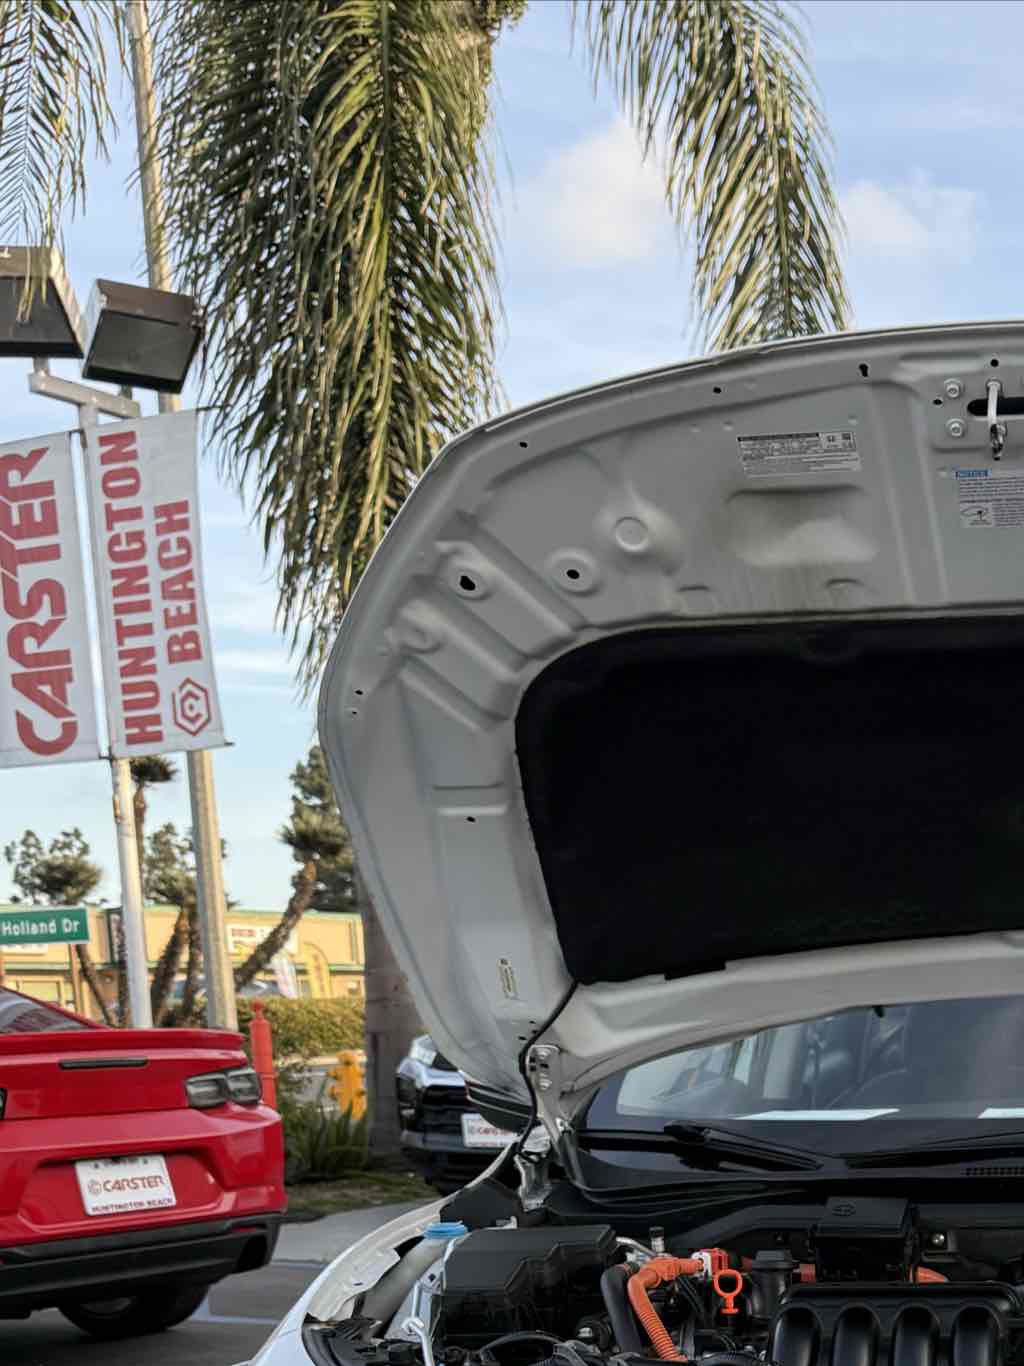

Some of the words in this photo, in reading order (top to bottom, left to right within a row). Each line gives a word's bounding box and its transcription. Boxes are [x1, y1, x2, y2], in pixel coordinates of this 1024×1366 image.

[0, 447, 78, 757] CARSTER
[98, 430, 164, 746] HUNTINGTON
[153, 500, 203, 665] BEACH
[1, 919, 57, 936] Holland
[62, 918, 81, 933] Dr
[103, 1175, 165, 1193] CARSTER
